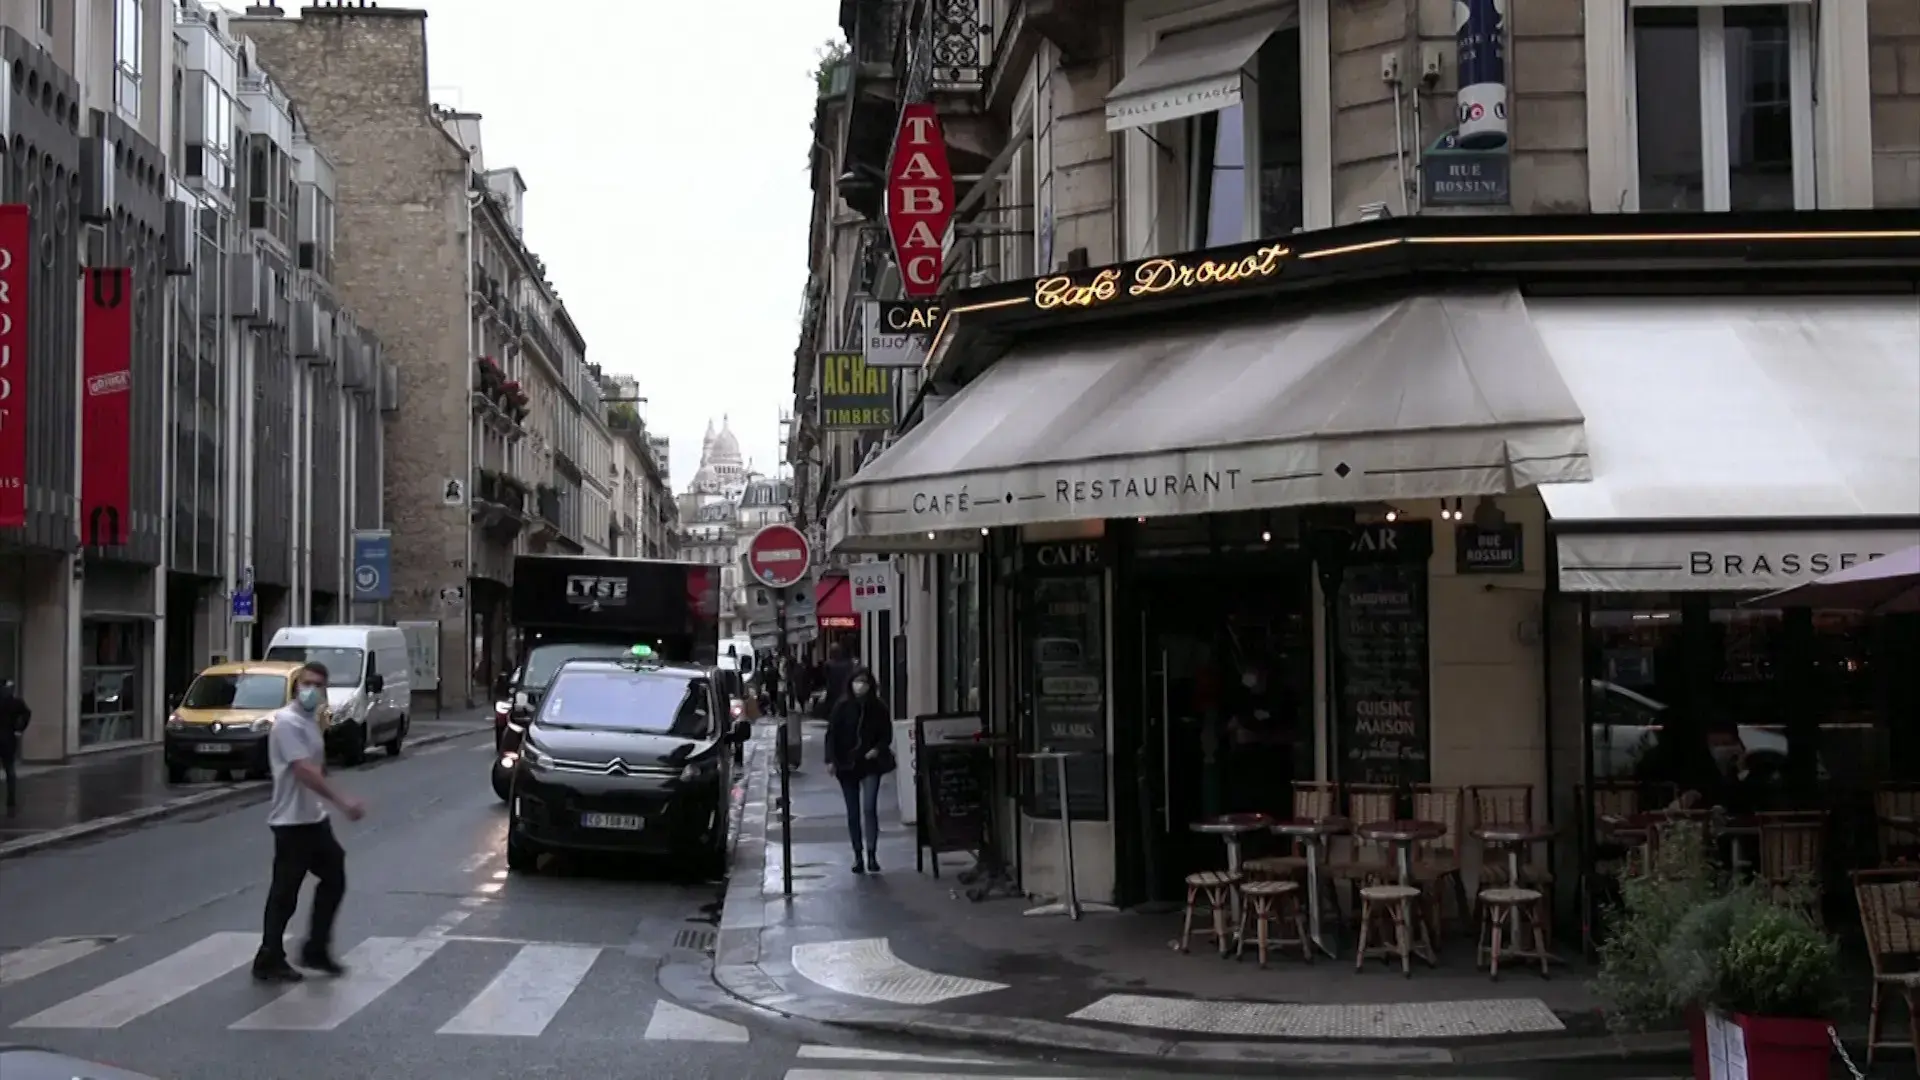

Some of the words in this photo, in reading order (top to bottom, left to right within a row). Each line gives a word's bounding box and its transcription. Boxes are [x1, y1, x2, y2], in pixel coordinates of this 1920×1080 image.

[1449, 164, 1482, 176] RUE
[1434, 180, 1497, 194] ROSSINI
[896, 116, 944, 285] TABAC
[1035, 268, 1122, 310] Café
[1129, 243, 1290, 297] Drouot
[888, 307, 941, 330] CAF
[824, 408, 891, 425] TIMBRES
[912, 485, 971, 514] CAFÉ
[1055, 468, 1242, 503] RESTAURANT
[1349, 527, 1398, 552] AR
[1477, 534, 1502, 548] RUE
[1466, 548, 1513, 562] ROSSINI
[1690, 551, 1887, 576] BRASSE
[1355, 700, 1413, 717] CUISINE
[1355, 716, 1416, 736] MAISON
